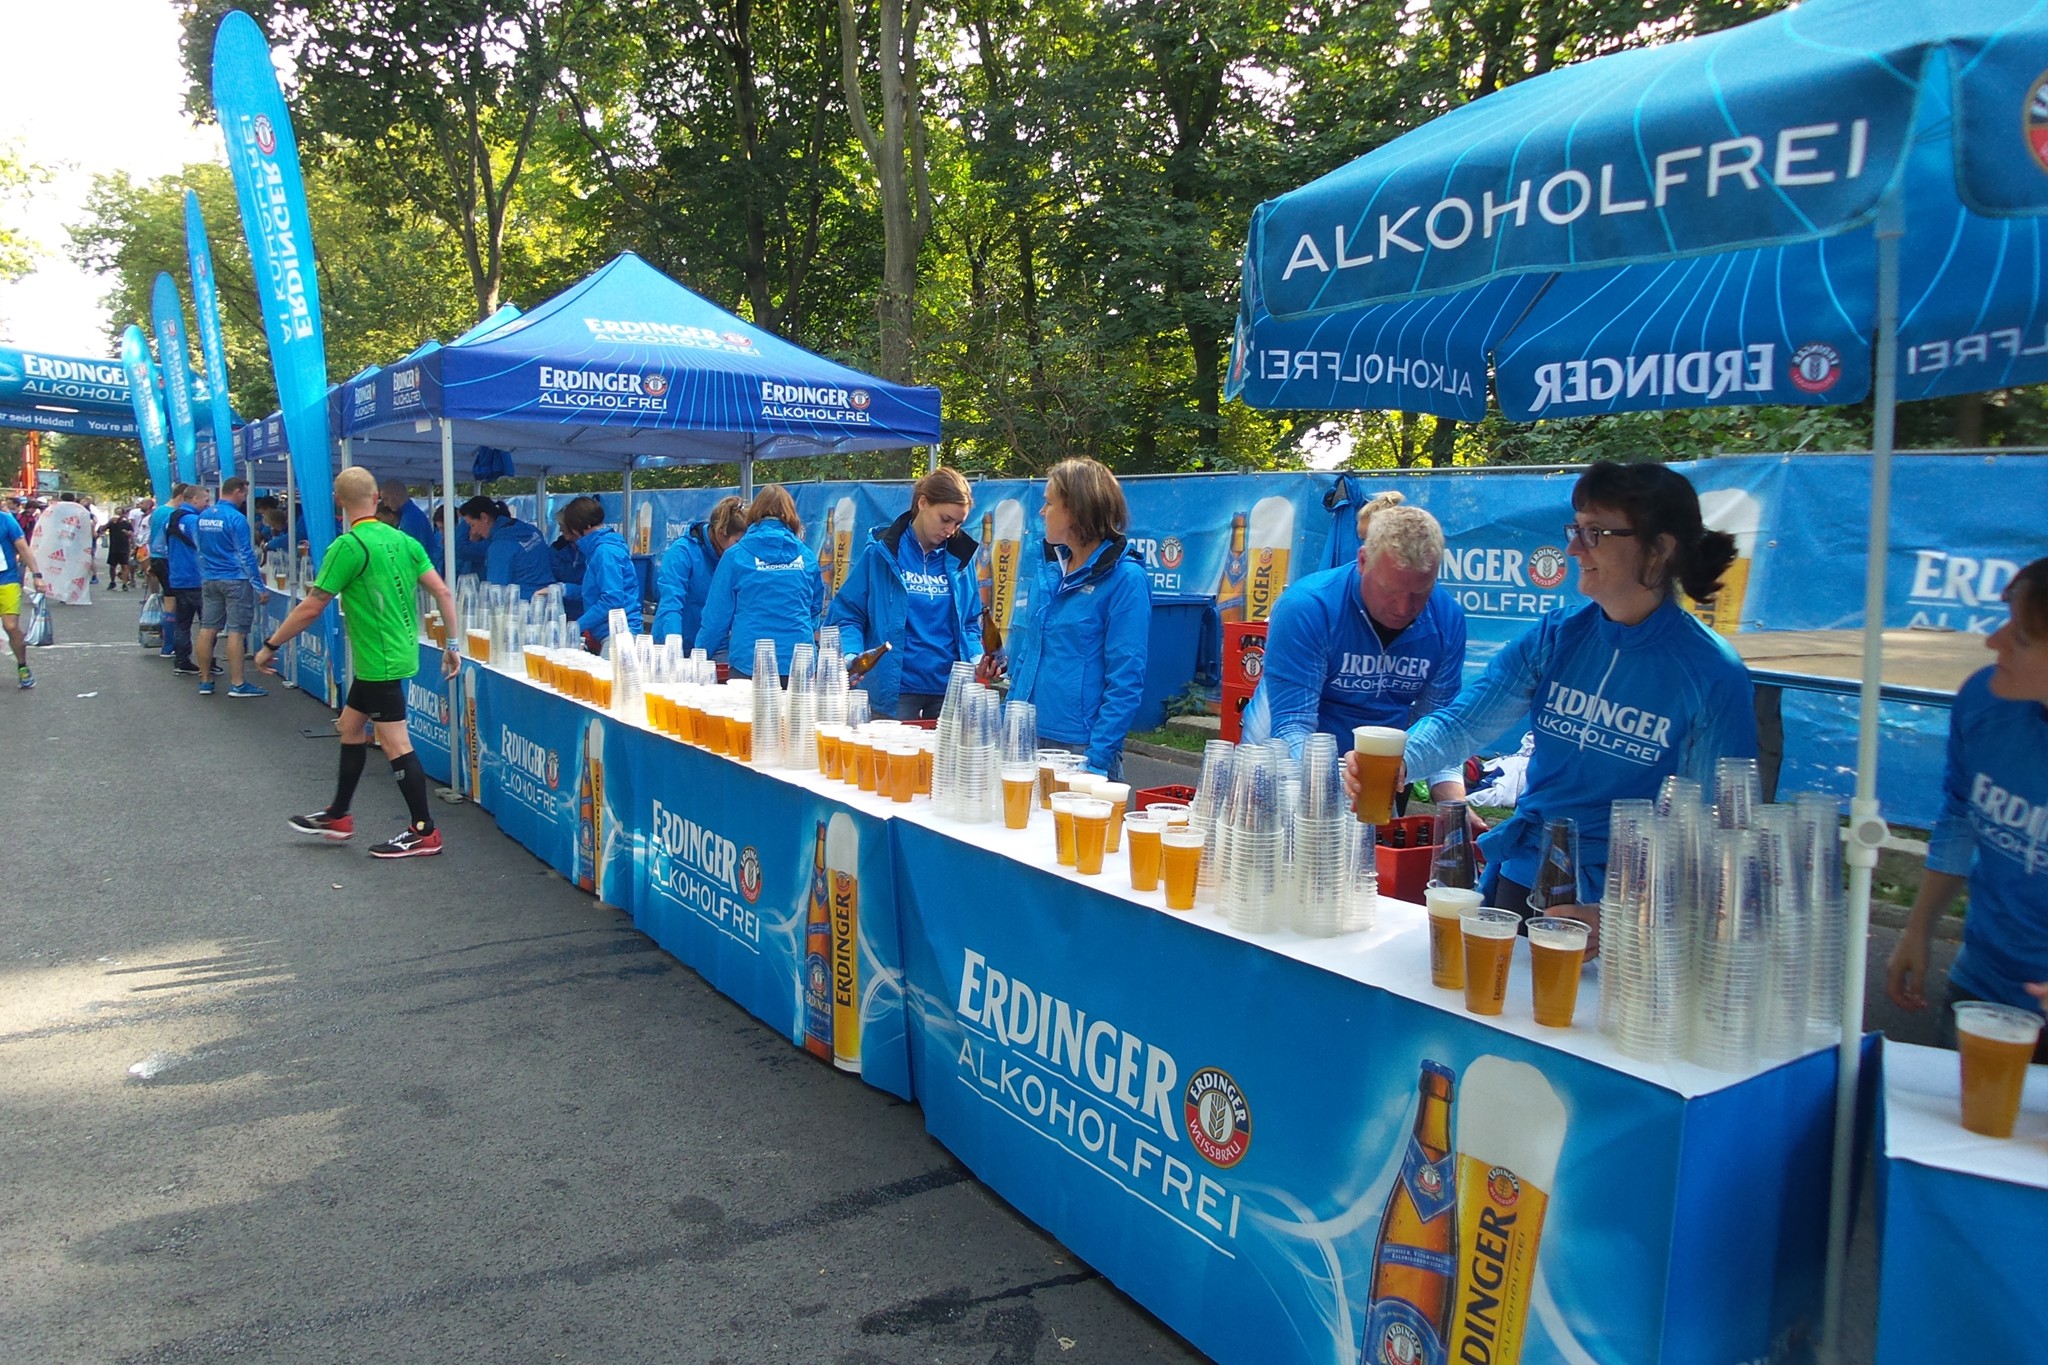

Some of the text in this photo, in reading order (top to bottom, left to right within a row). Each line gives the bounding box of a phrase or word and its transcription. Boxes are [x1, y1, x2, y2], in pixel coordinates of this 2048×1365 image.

[1282, 119, 1868, 281] ALKOHOLFREI
[584, 318, 723, 343] ERDINGER
[595, 333, 760, 355] ALKOHOLFREI
[22, 380, 131, 401] ALKOHOLF
[539, 366, 643, 395] ERDINGER
[539, 393, 667, 409] ALKOHOLFREI
[762, 382, 850, 408] ERDINGER
[9, 414, 32, 423] seid
[35, 415, 74, 427] Helden!
[88, 421, 120, 431] You're
[762, 405, 869, 422] ALKOHOLFREI
[834, 543, 846, 590] DINGER
[901, 570, 949, 585] RDING
[1438, 548, 1527, 587] NGER
[1530, 548, 1565, 565] ERDINGER
[995, 554, 1011, 622] RDINGER
[1252, 564, 1272, 622] INGER
[1455, 591, 1564, 613] OLFREI
[1340, 652, 1430, 679] ERDINGER
[1545, 681, 1670, 748] ERDINGER
[653, 799, 738, 894] ERDINGER
[652, 857, 760, 942] ALKOHOLFREI
[836, 892, 853, 1008] ERDINGER
[957, 947, 1179, 1141] ERDINGER
[1190, 1073, 1247, 1122] ERDINGER
[957, 1038, 1241, 1239] ALKOHOLFREI
[1190, 1119, 1241, 1161] WEISSBRÄU
[1460, 1206, 1517, 1365] DINGER
[1502, 1232, 1526, 1358] ALKOHOLFREI
